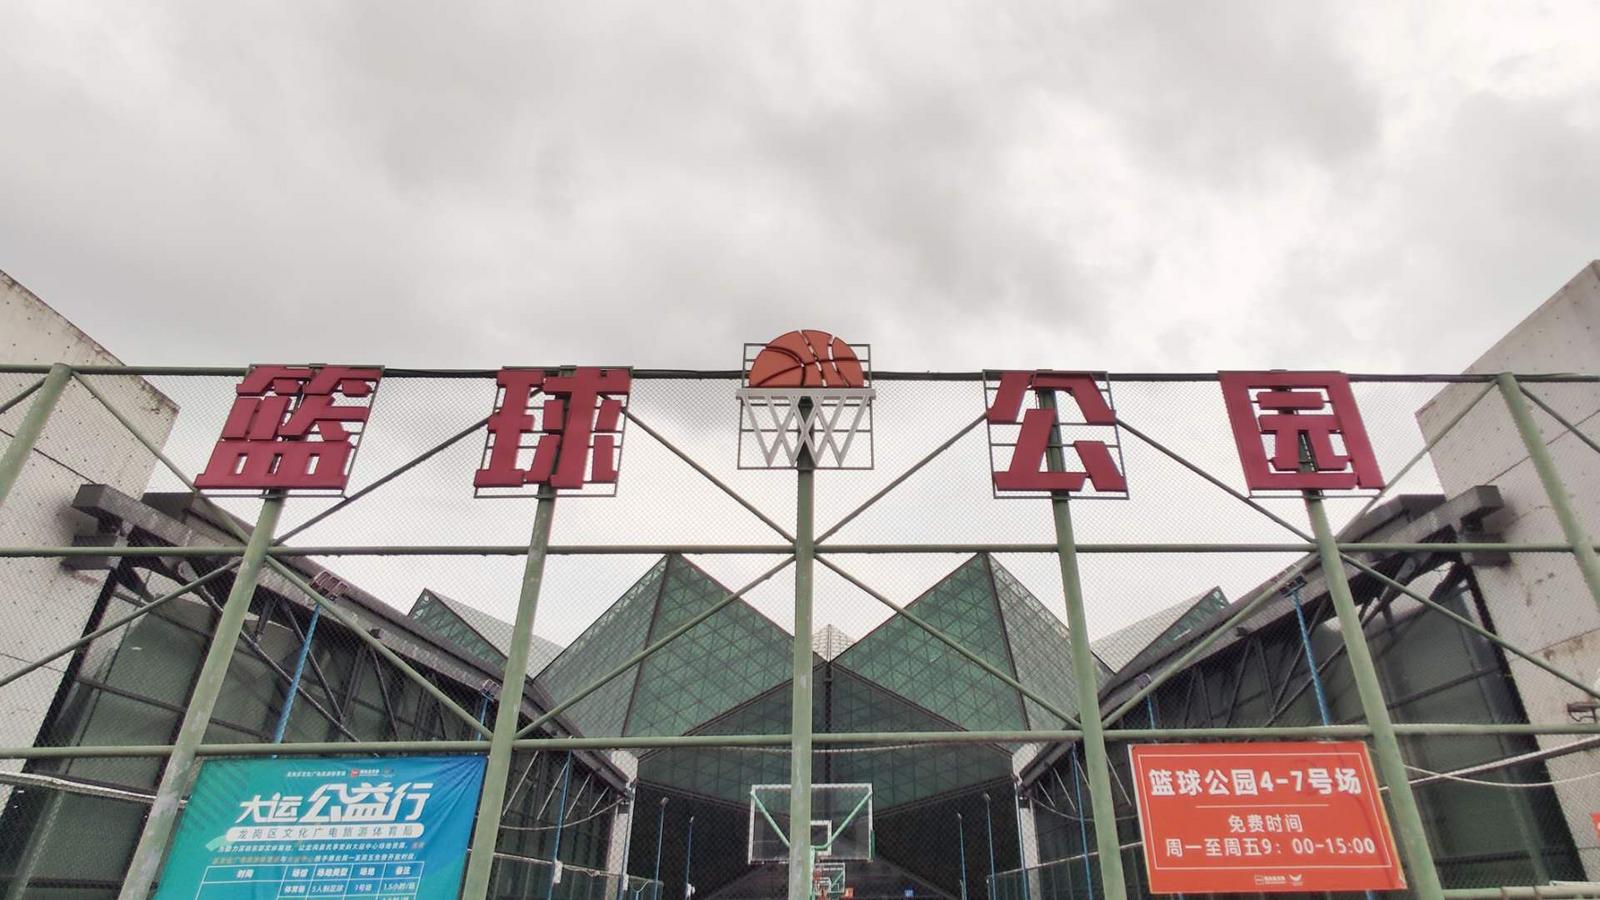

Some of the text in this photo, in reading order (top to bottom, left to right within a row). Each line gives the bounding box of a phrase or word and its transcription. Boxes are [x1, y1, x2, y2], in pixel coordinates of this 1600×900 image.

[1149, 768, 1362, 796] 篮球公园4-7号场
[235, 782, 434, 824] 大运公益行
[238, 826, 414, 840] 龙岗区文化广电旅游体育局
[1228, 814, 1303, 833] 免费时间
